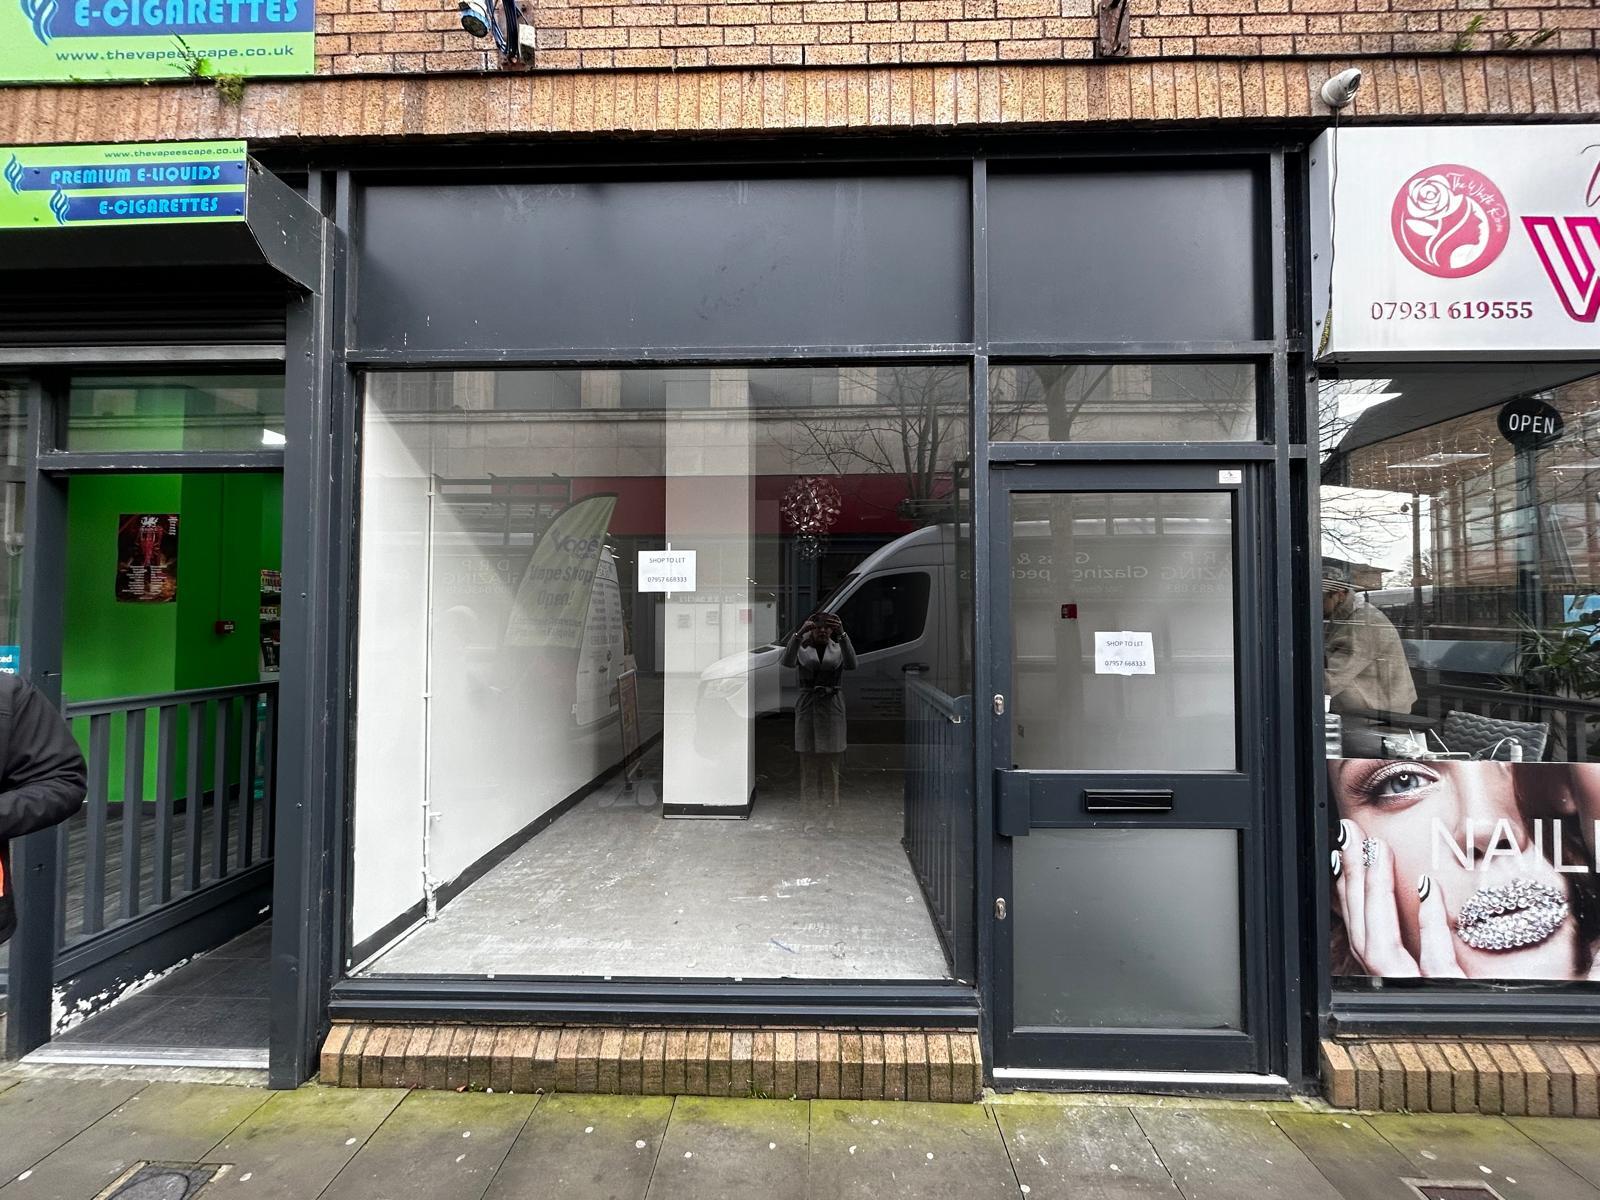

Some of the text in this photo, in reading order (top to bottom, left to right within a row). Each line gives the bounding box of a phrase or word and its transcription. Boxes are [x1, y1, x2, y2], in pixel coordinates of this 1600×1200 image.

[74, 0, 298, 27] E-CIGARETTES
[56, 45, 294, 62] www.thevapeescape.co.uk
[104, 147, 245, 159] www.thevapeescape.co.uk
[50, 165, 220, 185] PREMIUM E-LIQUIDS
[99, 197, 219, 215] E-CIGARETTES
[1371, 301, 1533, 320] 07931 619555
[1508, 413, 1555, 435] OPEN
[562, 565, 594, 586] Shop
[1431, 817, 1600, 874] NAIL
